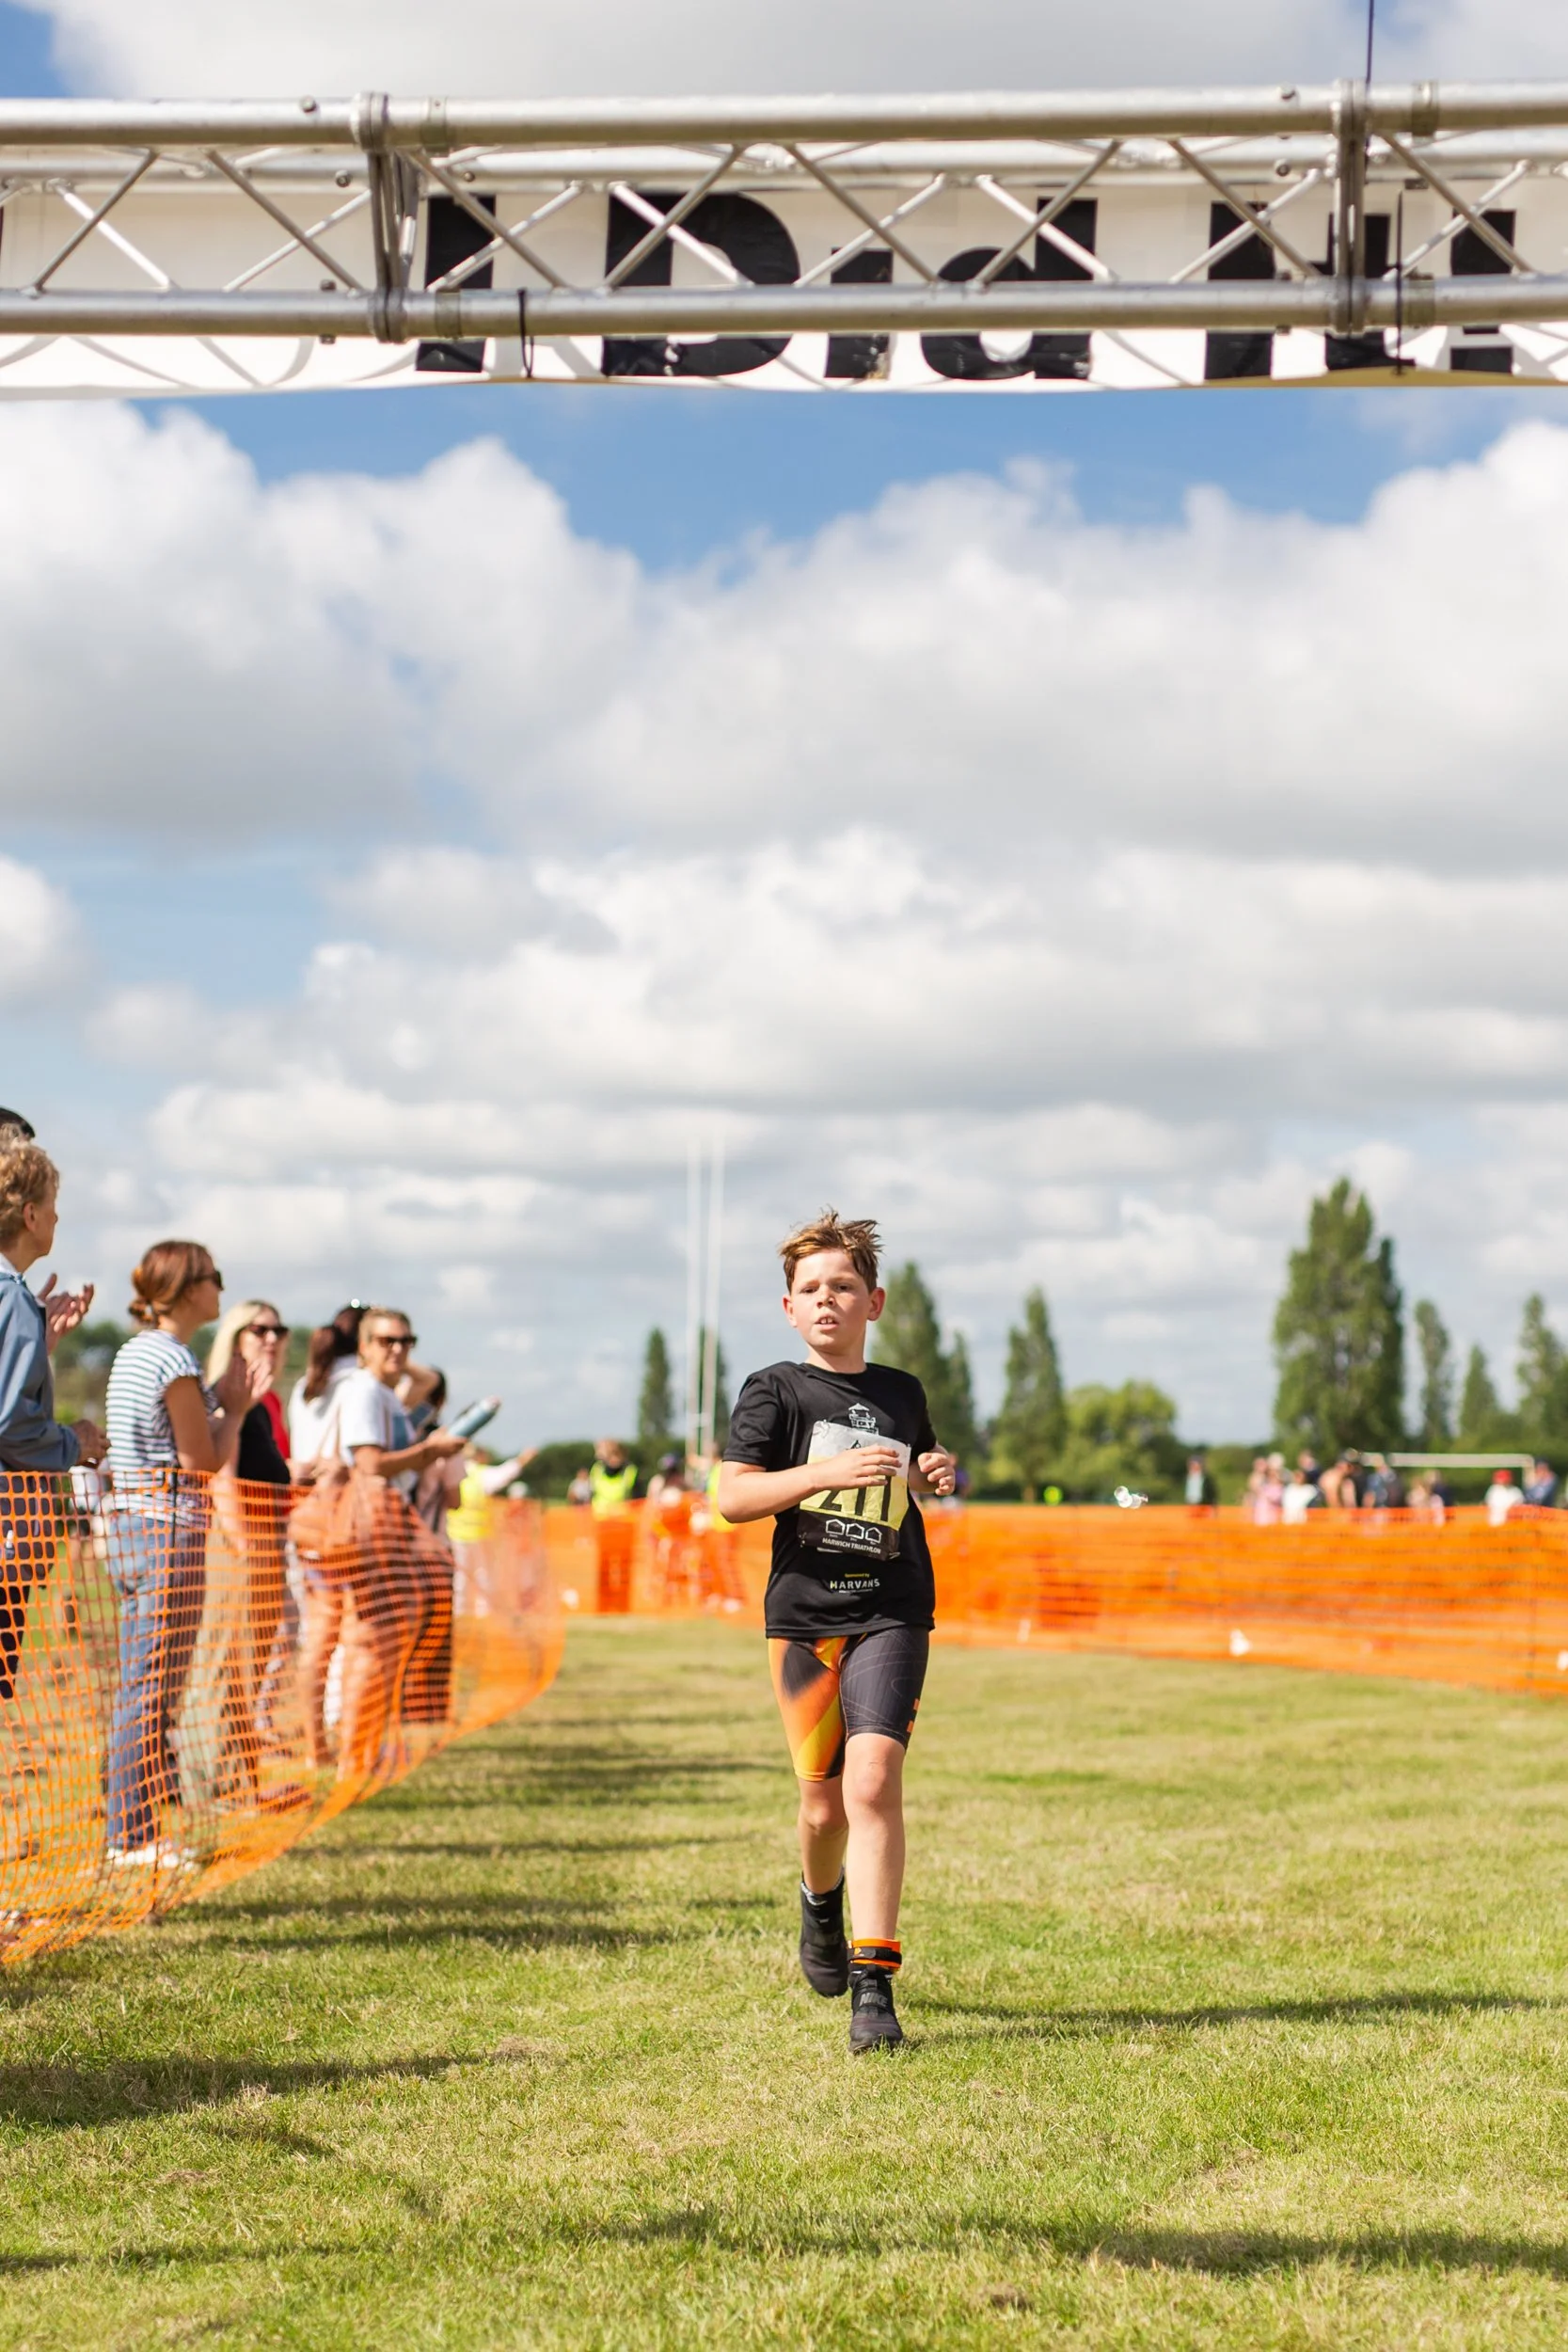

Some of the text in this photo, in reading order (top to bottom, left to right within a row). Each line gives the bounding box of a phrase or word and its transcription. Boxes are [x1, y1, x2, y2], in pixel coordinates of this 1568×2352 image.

[601, 192, 1099, 379] Did
[822, 1536, 881, 1554] HARWICH TRIATHLON
[830, 1579, 880, 1590] HARVANS
[859, 1992, 889, 2008] NIKE
